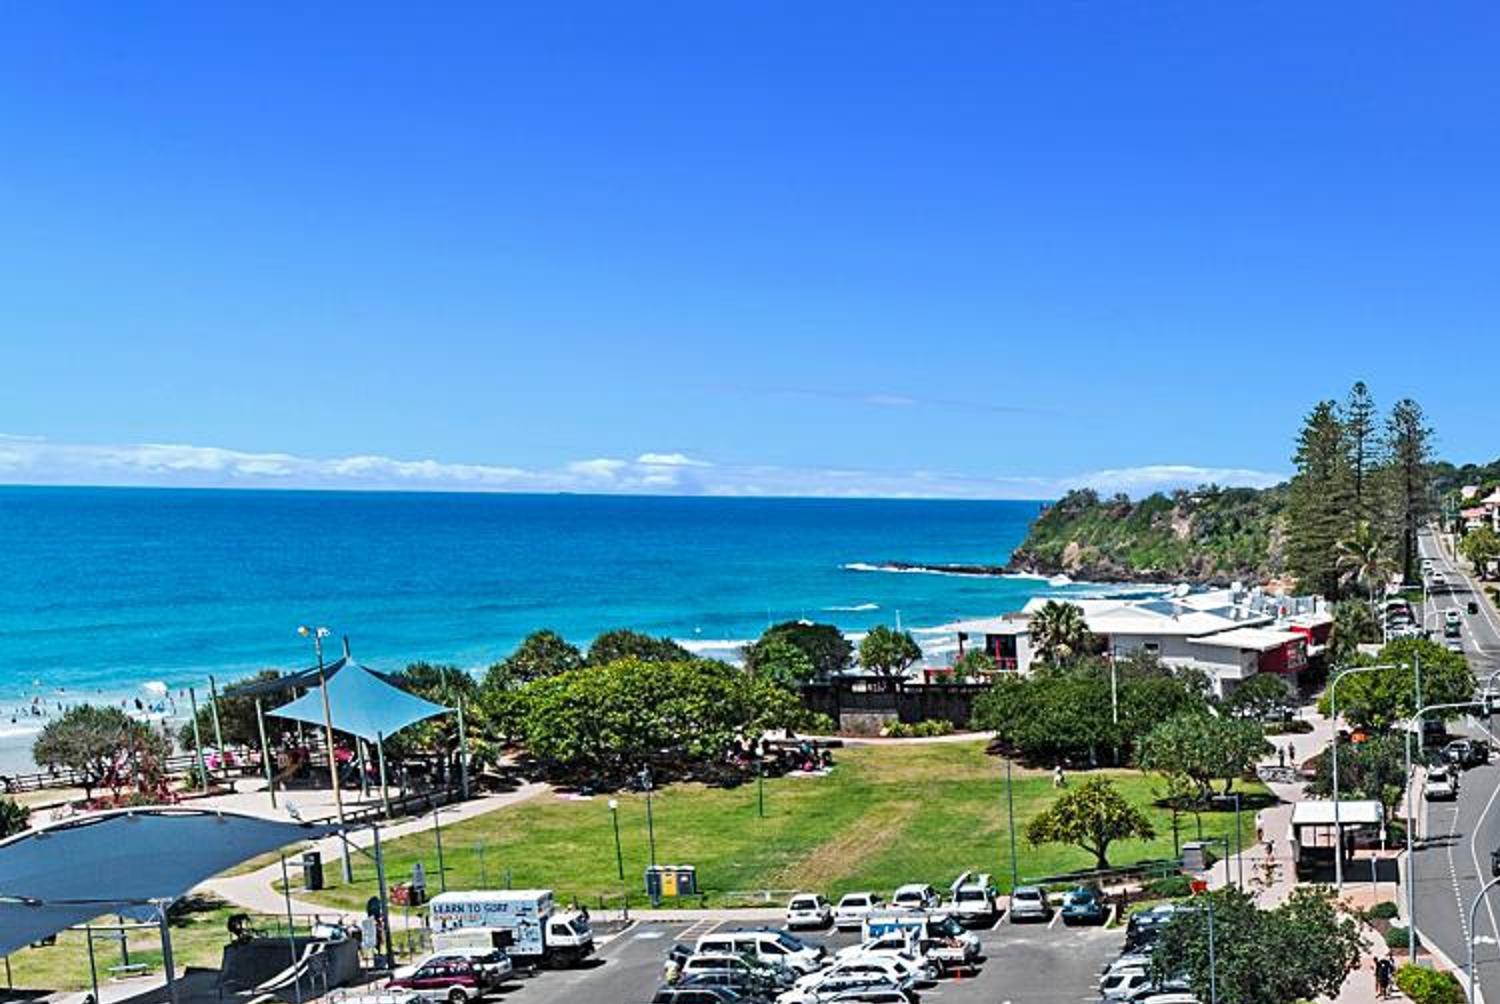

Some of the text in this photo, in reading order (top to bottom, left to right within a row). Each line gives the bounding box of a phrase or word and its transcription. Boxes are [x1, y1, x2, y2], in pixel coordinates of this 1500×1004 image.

[433, 903, 509, 913] LEARN TO SURF
